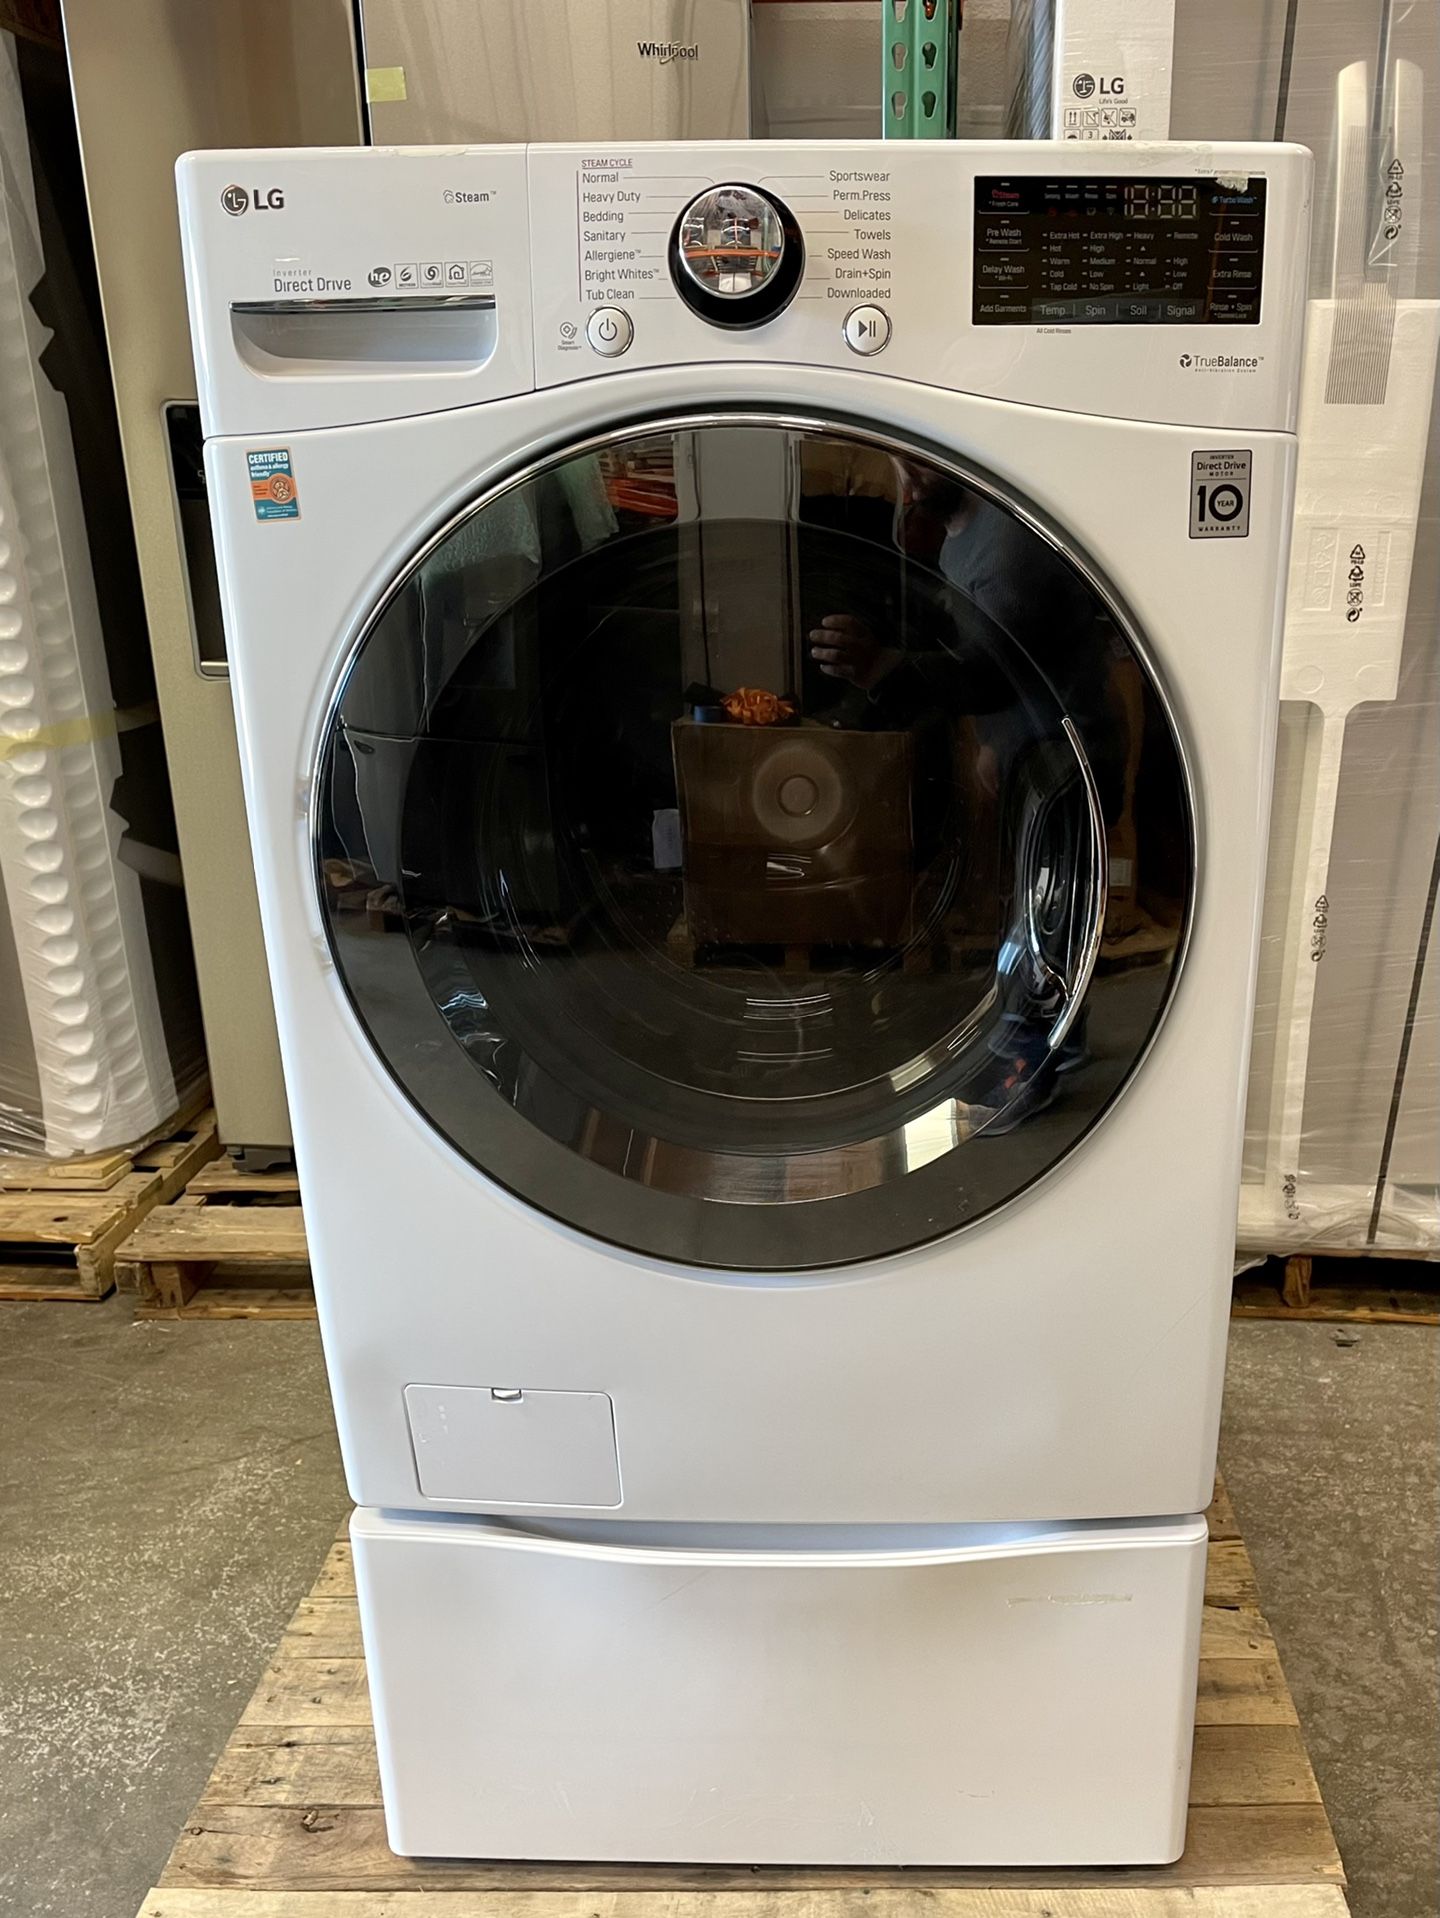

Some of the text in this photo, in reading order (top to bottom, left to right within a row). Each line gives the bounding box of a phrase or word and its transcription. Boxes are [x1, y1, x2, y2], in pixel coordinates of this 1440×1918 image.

[637, 41, 698, 61] Whirlpool
[1100, 77, 1124, 94] LG
[582, 158, 633, 168] STEAM CYCLE
[582, 172, 619, 183] Normal
[829, 170, 891, 183] Sportswear
[253, 188, 285, 210] LG
[582, 190, 641, 203] Heavy Duty
[583, 211, 624, 223] Bedding
[844, 209, 891, 221] Delicates
[583, 230, 626, 242] Sanitary
[854, 228, 891, 240] Towels
[986, 228, 1022, 237] Pre Wash
[1090, 232, 1124, 240] Extra High
[1134, 232, 1154, 241] Heavy
[1214, 233, 1253, 241] Cold Wash
[1050, 244, 1062, 252] Hot
[1090, 244, 1105, 253] High
[828, 248, 891, 261] Speed Wash
[1173, 258, 1188, 266] High
[835, 268, 891, 280] Drain+Spin
[982, 265, 1025, 274] Delay Wash
[1050, 270, 1064, 278] Cold
[1090, 270, 1104, 278] Low
[1213, 270, 1252, 278] Extra Rinse
[584, 270, 615, 282] Bright
[274, 277, 352, 292] Direct Drive
[1050, 283, 1062, 291] Tap
[1100, 283, 1114, 291] Spin
[1132, 283, 1149, 291] Light
[586, 288, 634, 300] Tub Clean
[828, 287, 891, 298] Downloaded
[1040, 305, 1066, 316] Temp
[1086, 305, 1106, 316] Spin
[1130, 305, 1147, 315] Soil
[1167, 305, 1196, 317] Signal
[1236, 304, 1252, 312] Spin
[248, 452, 288, 464] CERTIFIED
[1197, 461, 1246, 470] Direct Drive
[1197, 484, 1243, 522] 10
